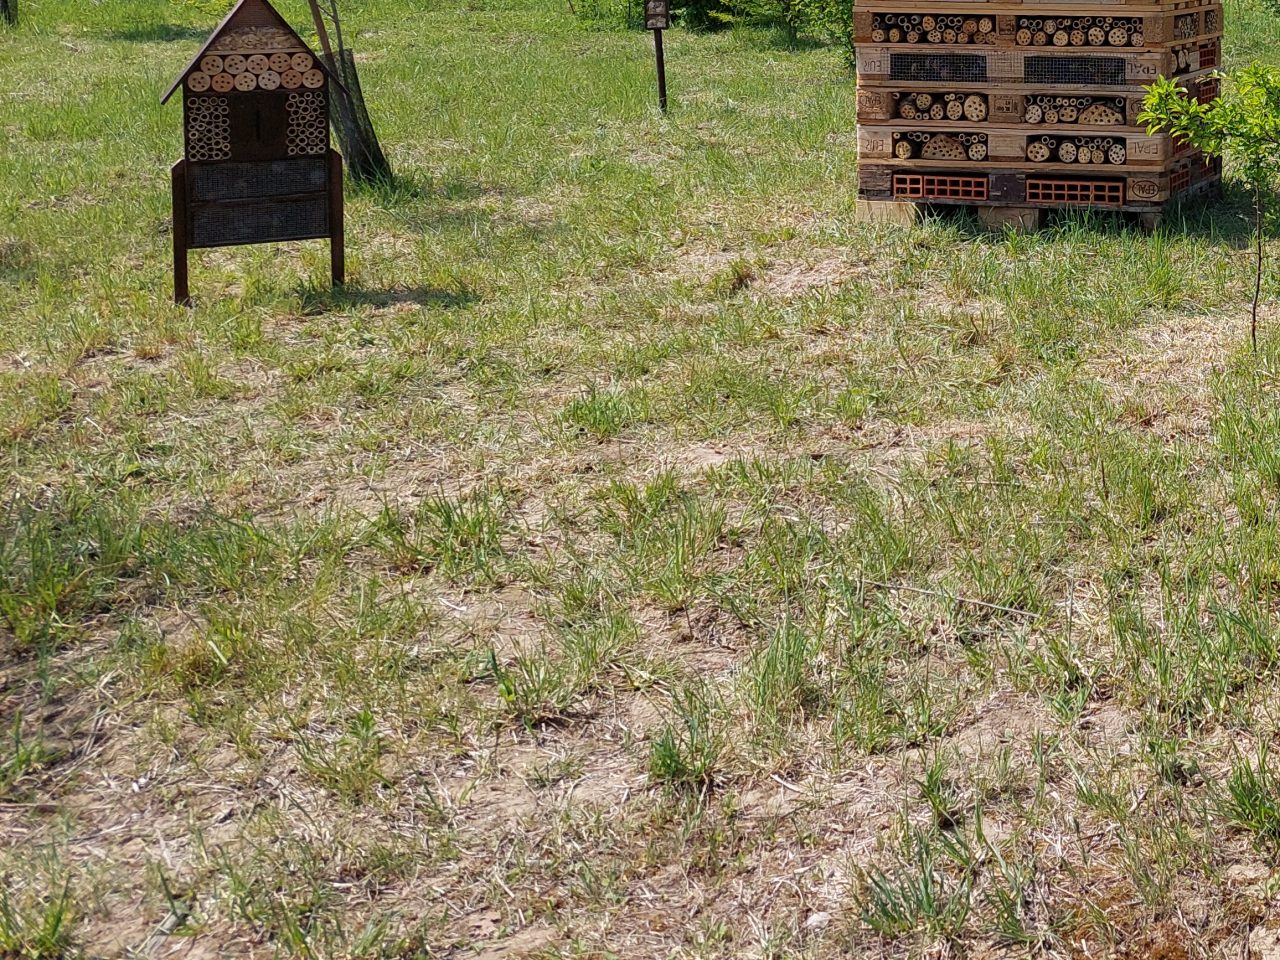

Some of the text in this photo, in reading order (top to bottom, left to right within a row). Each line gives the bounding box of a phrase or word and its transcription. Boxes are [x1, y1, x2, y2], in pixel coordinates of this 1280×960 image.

[863, 60, 882, 73] EUR
[1126, 62, 1157, 75] EPAL
[866, 139, 884, 152] EUR
[1133, 141, 1159, 155] EPAL
[1135, 184, 1155, 195] EPAL
